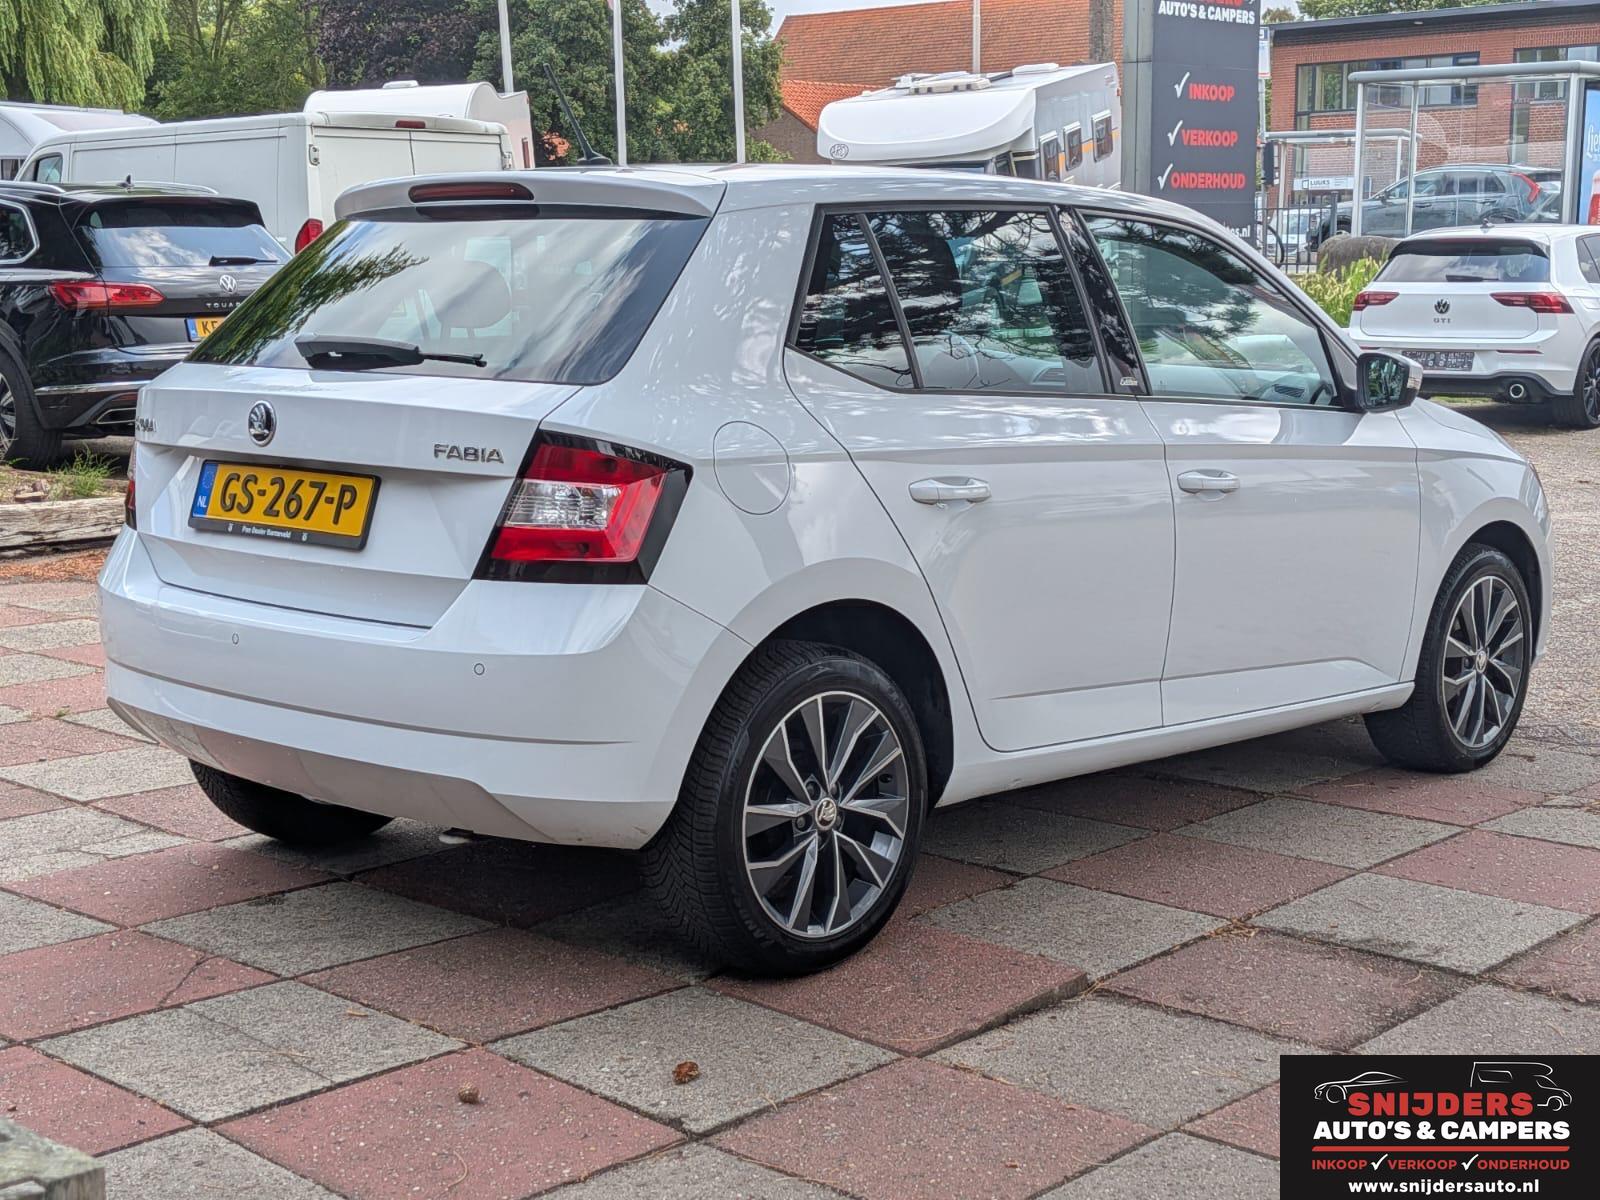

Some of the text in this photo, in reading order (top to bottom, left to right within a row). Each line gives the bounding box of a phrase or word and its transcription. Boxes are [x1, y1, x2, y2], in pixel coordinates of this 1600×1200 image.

[1158, 0, 1255, 24] AUTO'S & CAMPERS
[1189, 83, 1235, 101] INKOOP
[1181, 129, 1239, 147] VERKOOP
[1171, 172, 1246, 189] ONDERHOUD
[433, 443, 505, 464] FABIA
[197, 495, 207, 508] NL
[220, 472, 358, 525] GS-267-P
